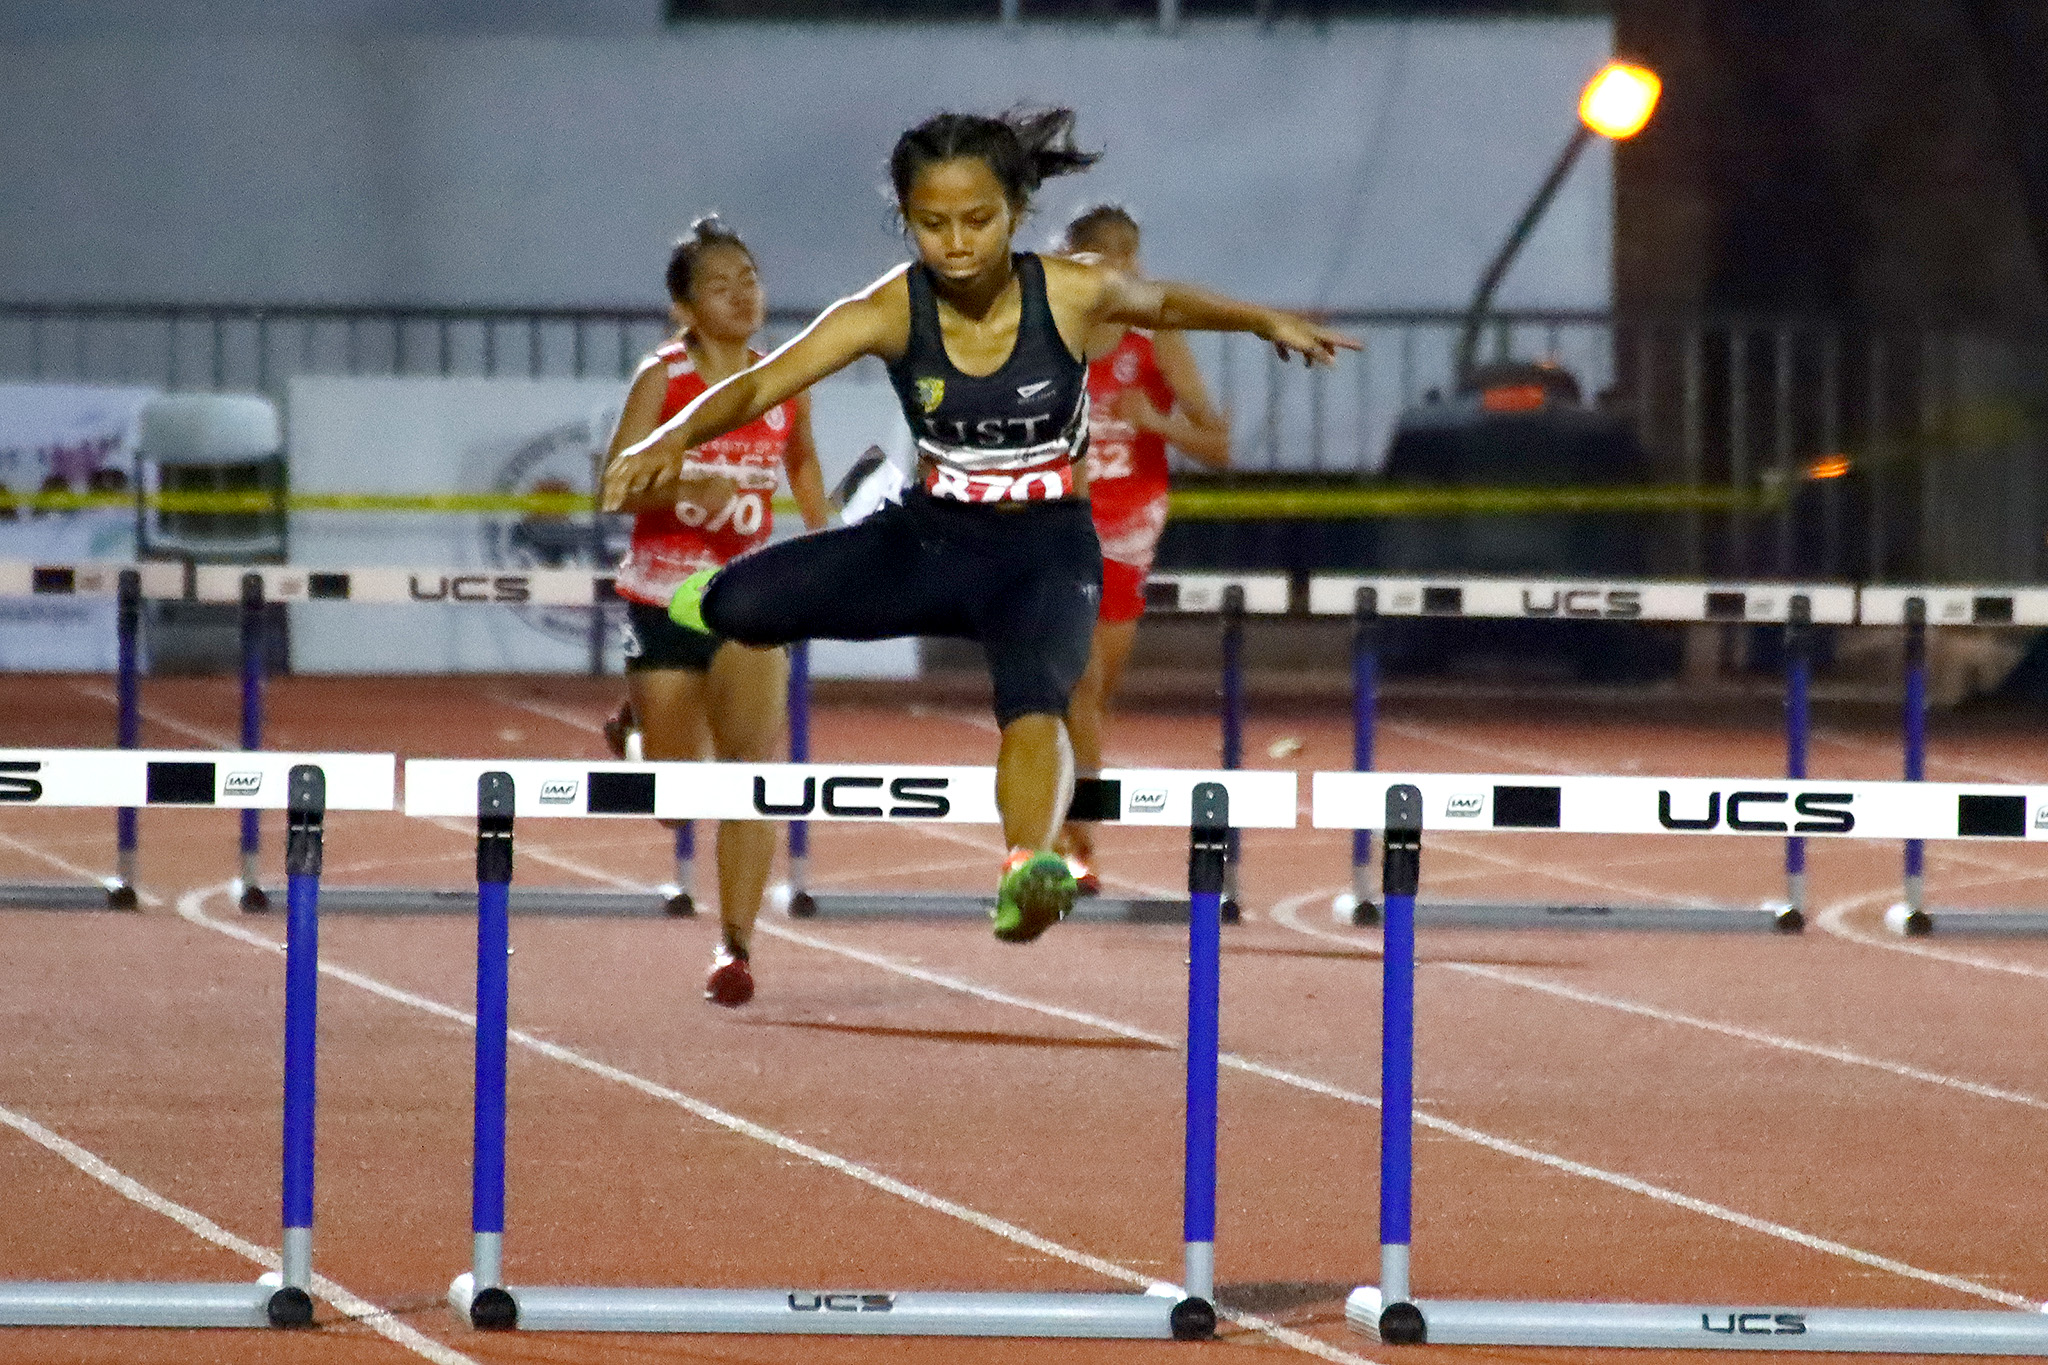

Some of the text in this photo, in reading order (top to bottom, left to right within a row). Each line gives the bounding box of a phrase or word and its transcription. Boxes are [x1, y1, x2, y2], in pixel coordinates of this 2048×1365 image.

[924, 413, 1050, 445] UST
[931, 465, 1064, 502] 870
[408, 575, 531, 603] UCS
[1522, 589, 1641, 618] UCS
[753, 776, 950, 818] UCS
[1658, 790, 1855, 833] UCS
[787, 1293, 895, 1312] UCS
[1701, 1313, 1808, 1335] UCS
